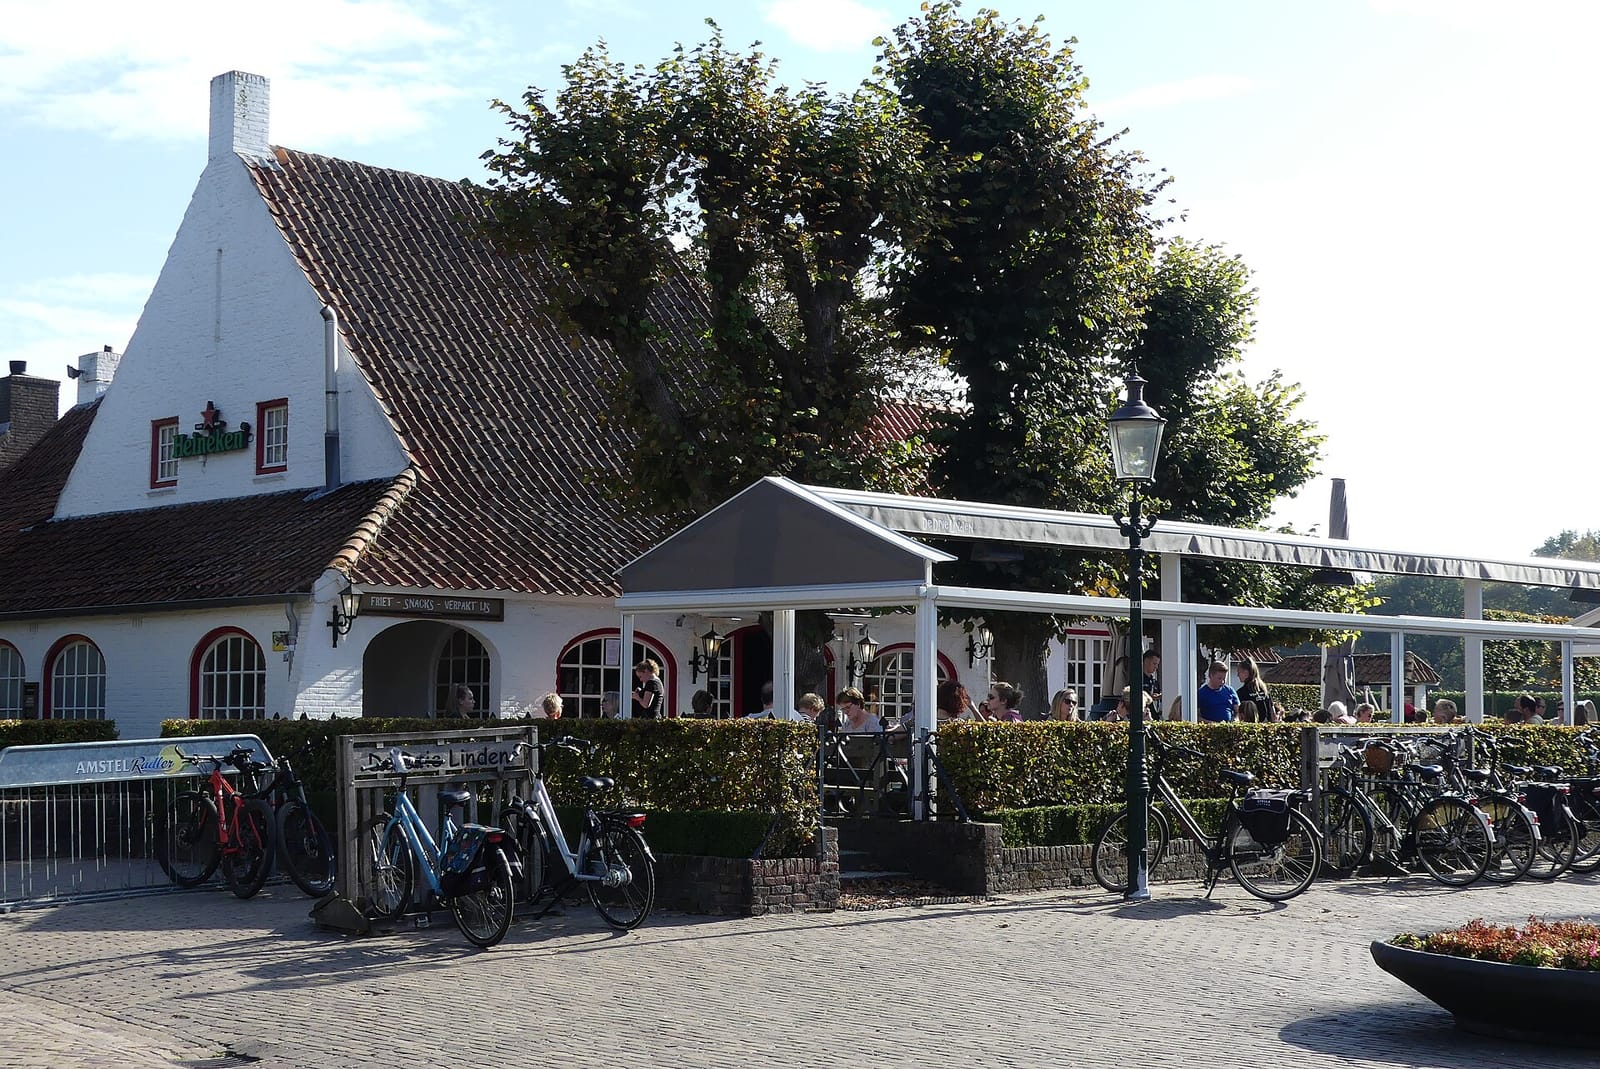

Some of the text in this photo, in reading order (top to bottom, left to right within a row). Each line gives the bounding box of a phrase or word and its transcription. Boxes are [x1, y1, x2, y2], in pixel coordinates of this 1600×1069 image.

[173, 430, 244, 458] Heineken
[370, 596, 394, 607] FRIET
[403, 598, 434, 611] SNACKS
[444, 600, 478, 611] VERPAKT
[75, 756, 175, 774] AMSTEL Radler
[449, 746, 509, 768] Linden
